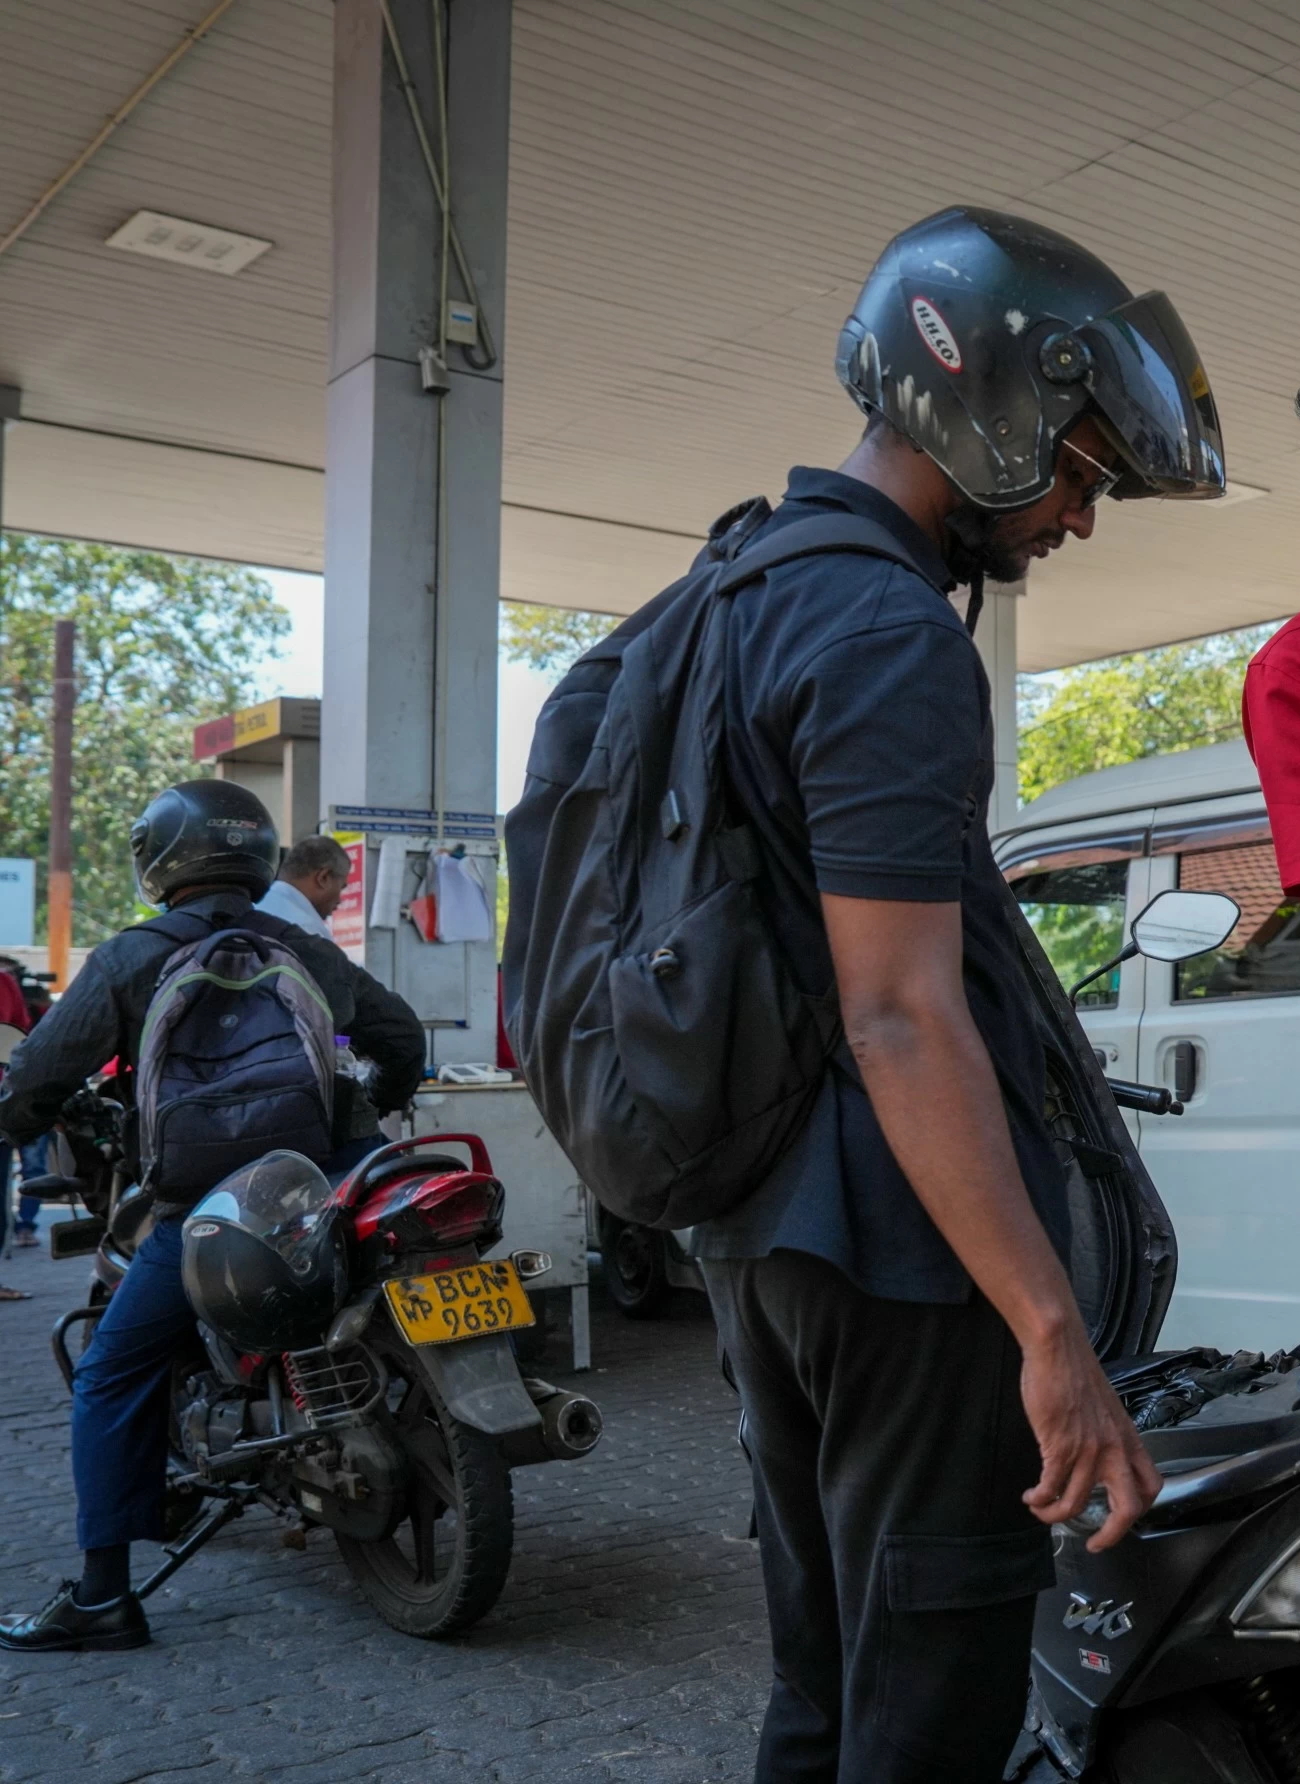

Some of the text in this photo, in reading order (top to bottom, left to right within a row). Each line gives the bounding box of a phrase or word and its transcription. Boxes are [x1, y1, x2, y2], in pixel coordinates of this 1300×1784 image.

[433, 1266, 504, 1303] BCN
[400, 1300, 433, 1323] WP
[442, 1297, 513, 1336] 9639
